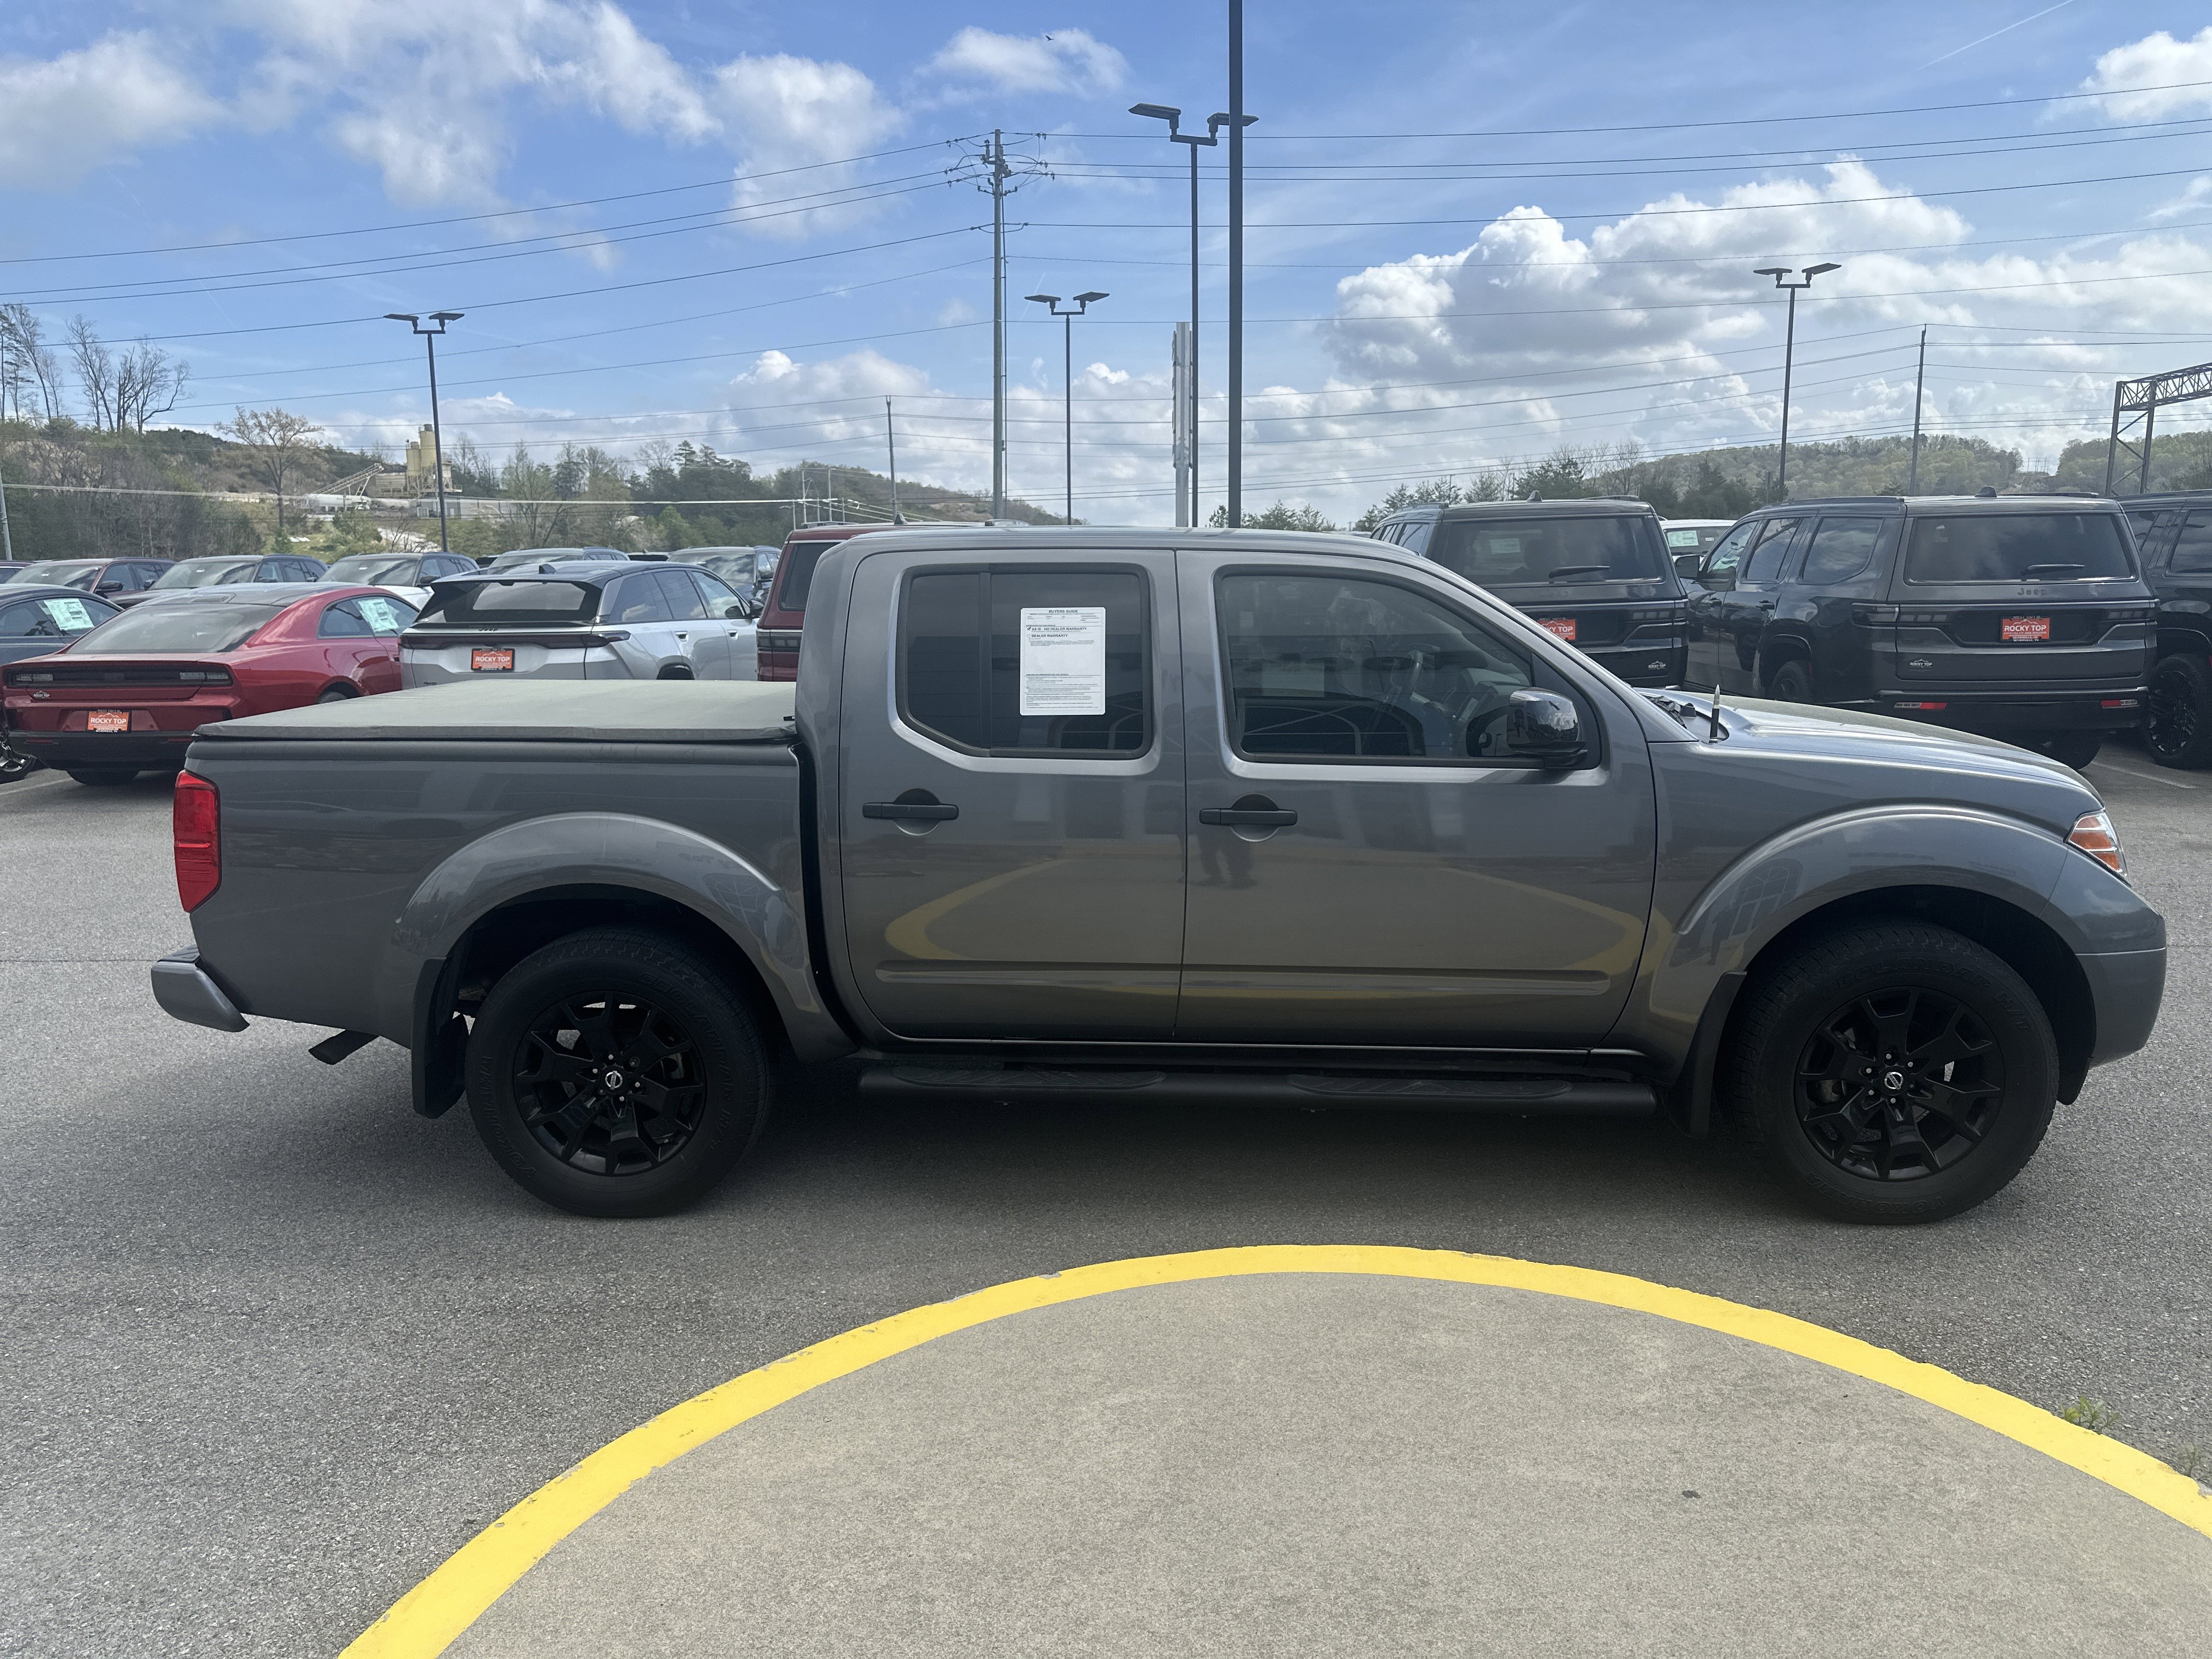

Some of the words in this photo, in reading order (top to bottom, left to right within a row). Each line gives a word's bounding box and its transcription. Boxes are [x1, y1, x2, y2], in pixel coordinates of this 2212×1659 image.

[2017, 588, 2046, 597] Jeep
[1821, 957, 1993, 1000] GEOLANDAR
[1994, 990, 2032, 1032] H/T
[639, 971, 734, 1104] GEOLANDAR
[481, 1056, 537, 1180] YOKOHAMA
[1804, 1171, 1949, 1215] YOKOHAMA
